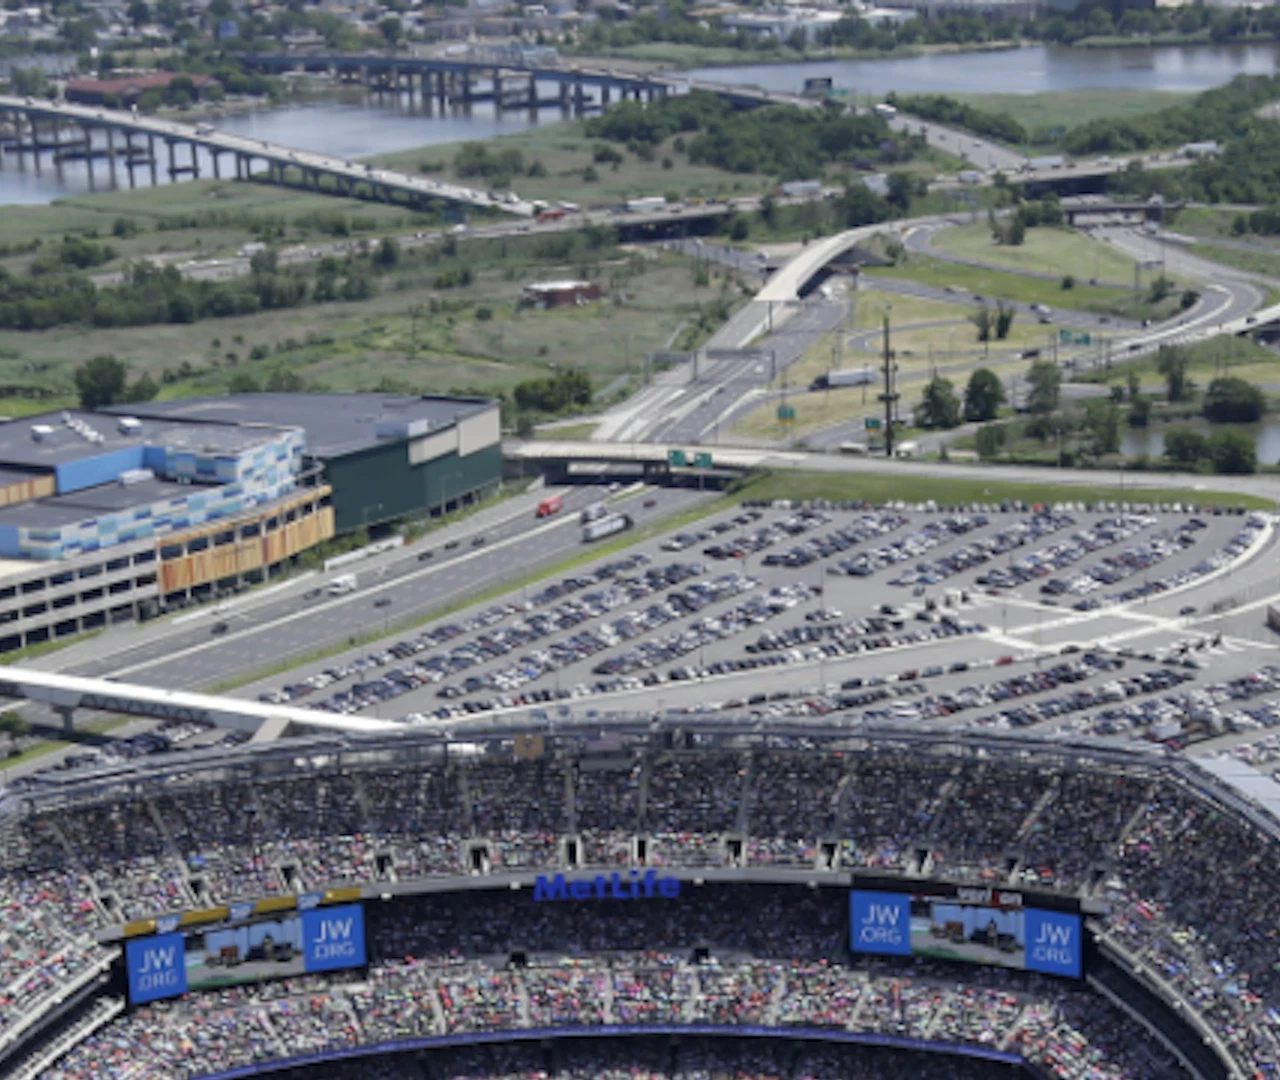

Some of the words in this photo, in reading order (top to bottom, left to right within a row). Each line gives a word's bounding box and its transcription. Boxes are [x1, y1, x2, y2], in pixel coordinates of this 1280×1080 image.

[533, 869, 680, 901] MetLife
[862, 903, 901, 926] JW
[312, 917, 354, 943] JW
[1035, 922, 1073, 946] JW
[138, 945, 176, 974] JW
